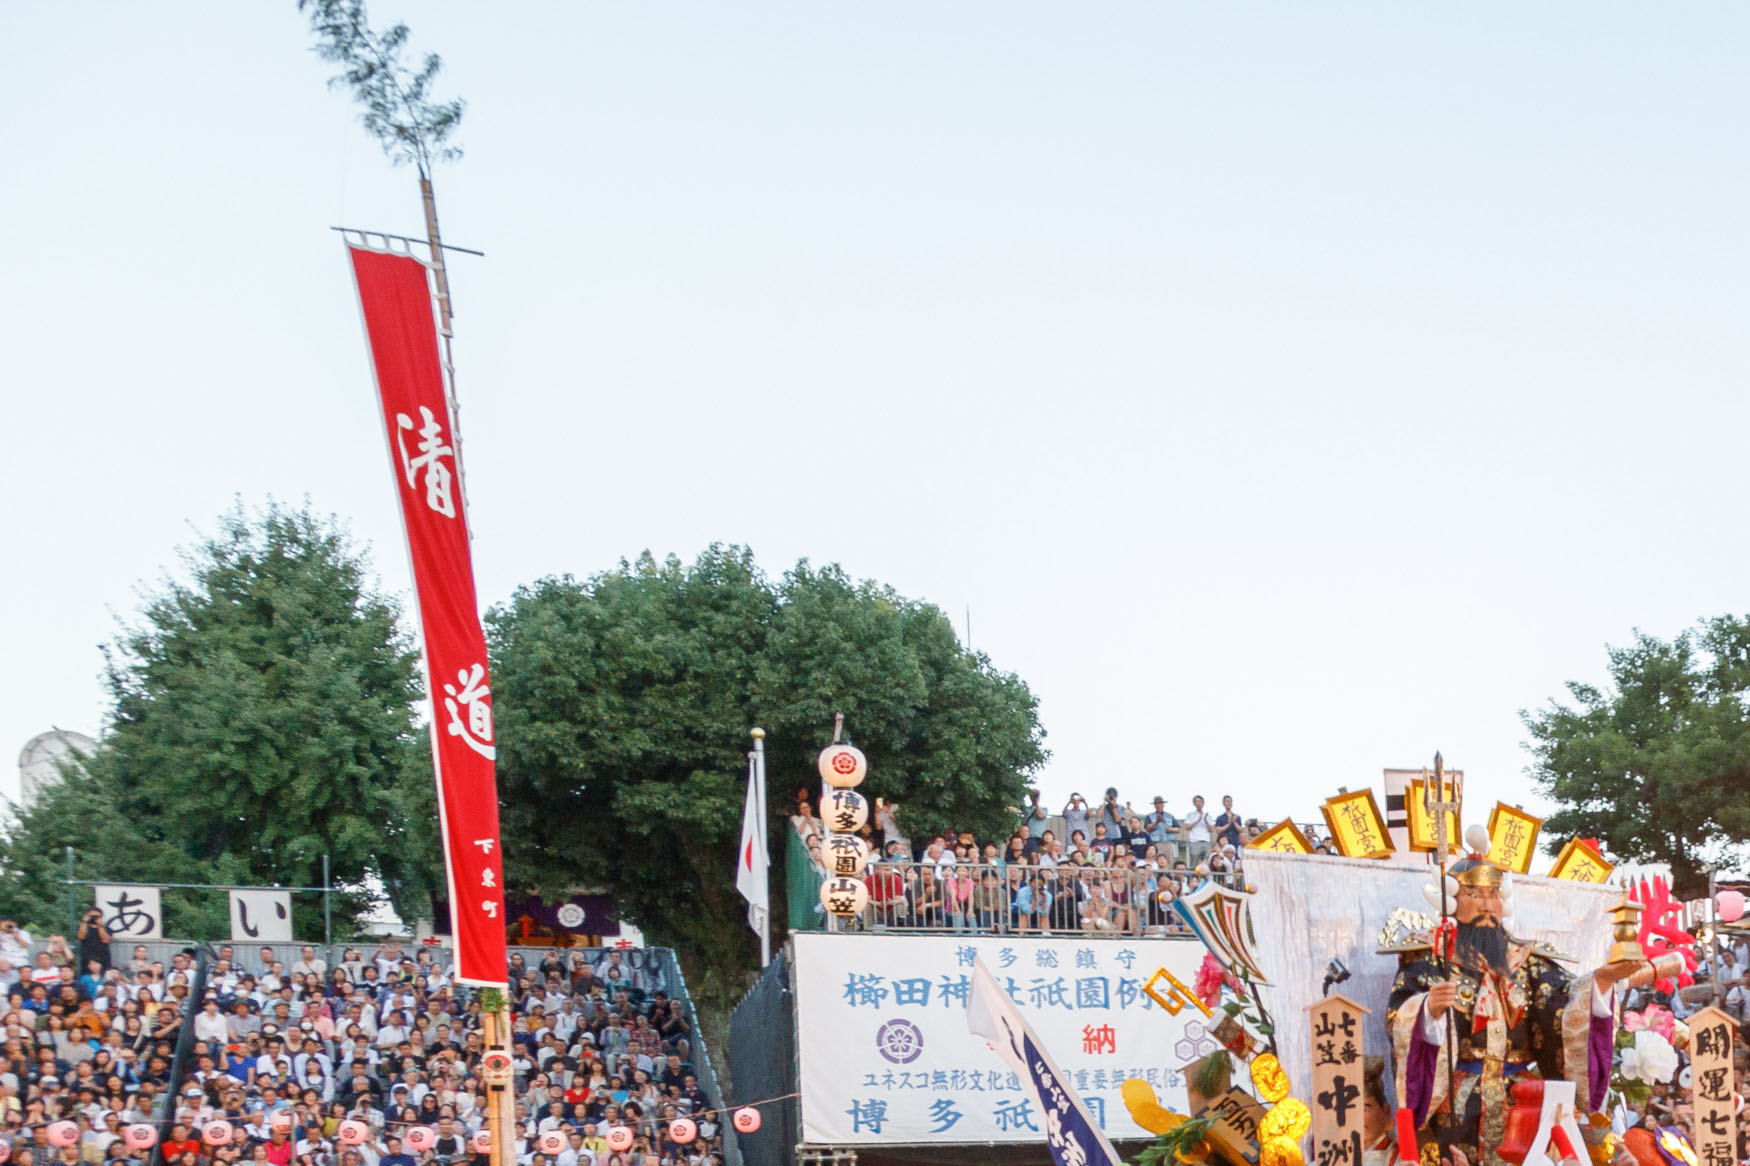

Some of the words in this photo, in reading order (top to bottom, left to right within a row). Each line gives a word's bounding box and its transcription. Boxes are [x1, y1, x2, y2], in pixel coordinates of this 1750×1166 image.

[397, 406, 497, 761] 清道
[105, 890, 155, 936] あ
[236, 897, 287, 938] い
[954, 945, 1137, 970] 博多総鎮守
[842, 972, 1234, 1010] 櫛田神社祇園例
[1082, 1023, 1116, 1055] 納
[1314, 1011, 1342, 1067] 山笠
